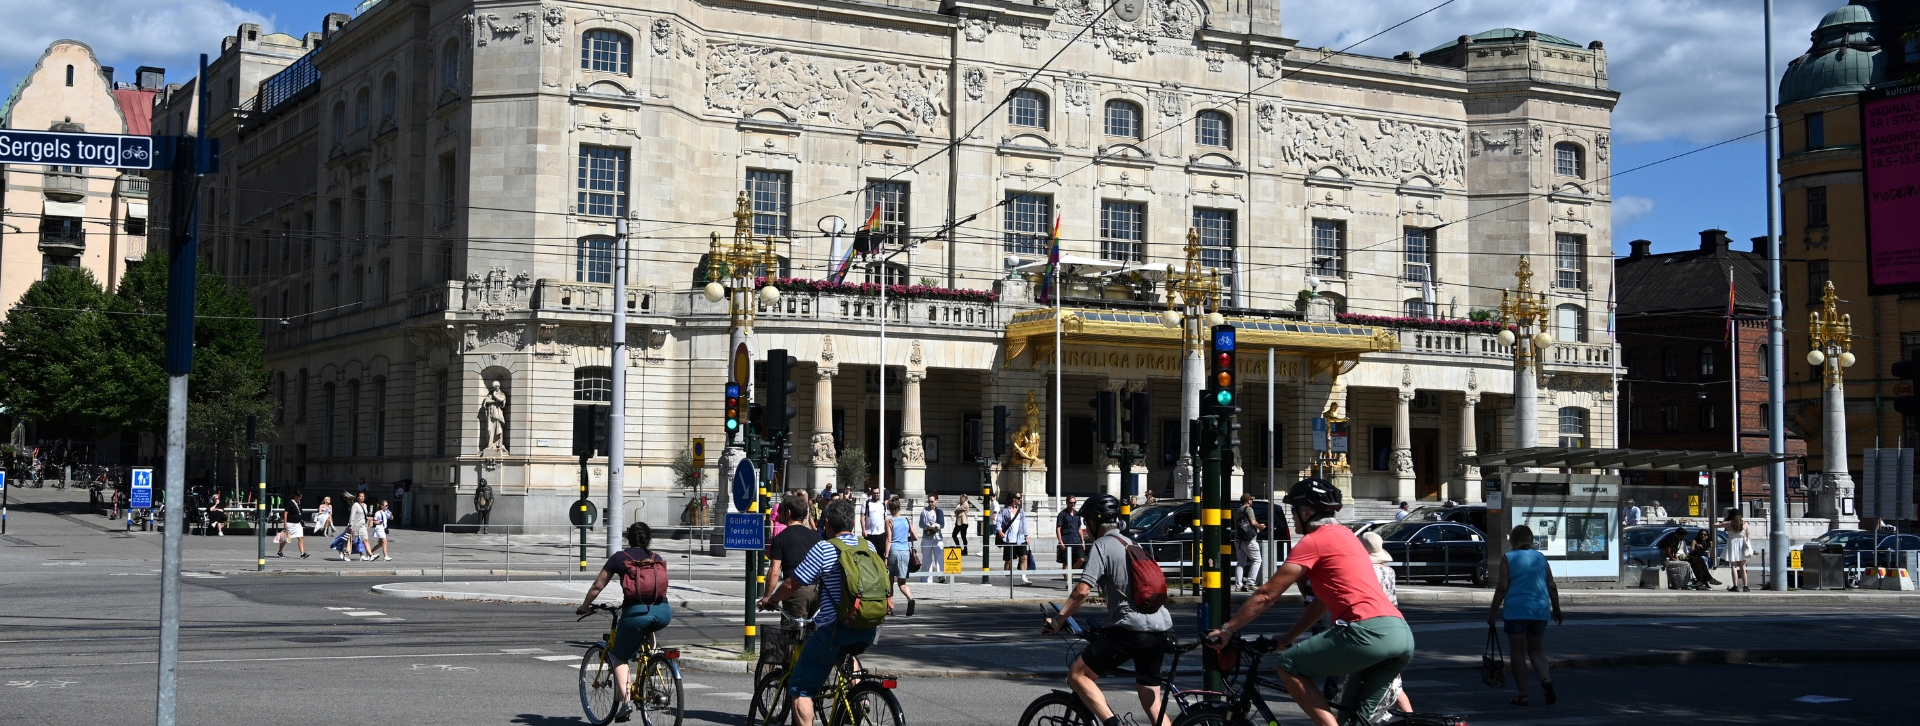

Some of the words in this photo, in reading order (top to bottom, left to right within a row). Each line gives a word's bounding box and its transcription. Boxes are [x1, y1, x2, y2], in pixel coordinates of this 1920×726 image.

[1869, 102, 1913, 117] VAGINAL
[1870, 117, 1883, 129] ÄR
[1886, 117, 1890, 126] I
[1892, 112, 1920, 126] STOC
[1870, 130, 1920, 147] MAGNIFIC
[0, 135, 71, 162] Sergels
[77, 140, 116, 165] torg
[1871, 142, 1919, 157] PRODUCT
[1048, 351, 1130, 369] KUNGLIGA
[1237, 358, 1299, 376] TEATRN
[753, 518, 760, 526] ej
